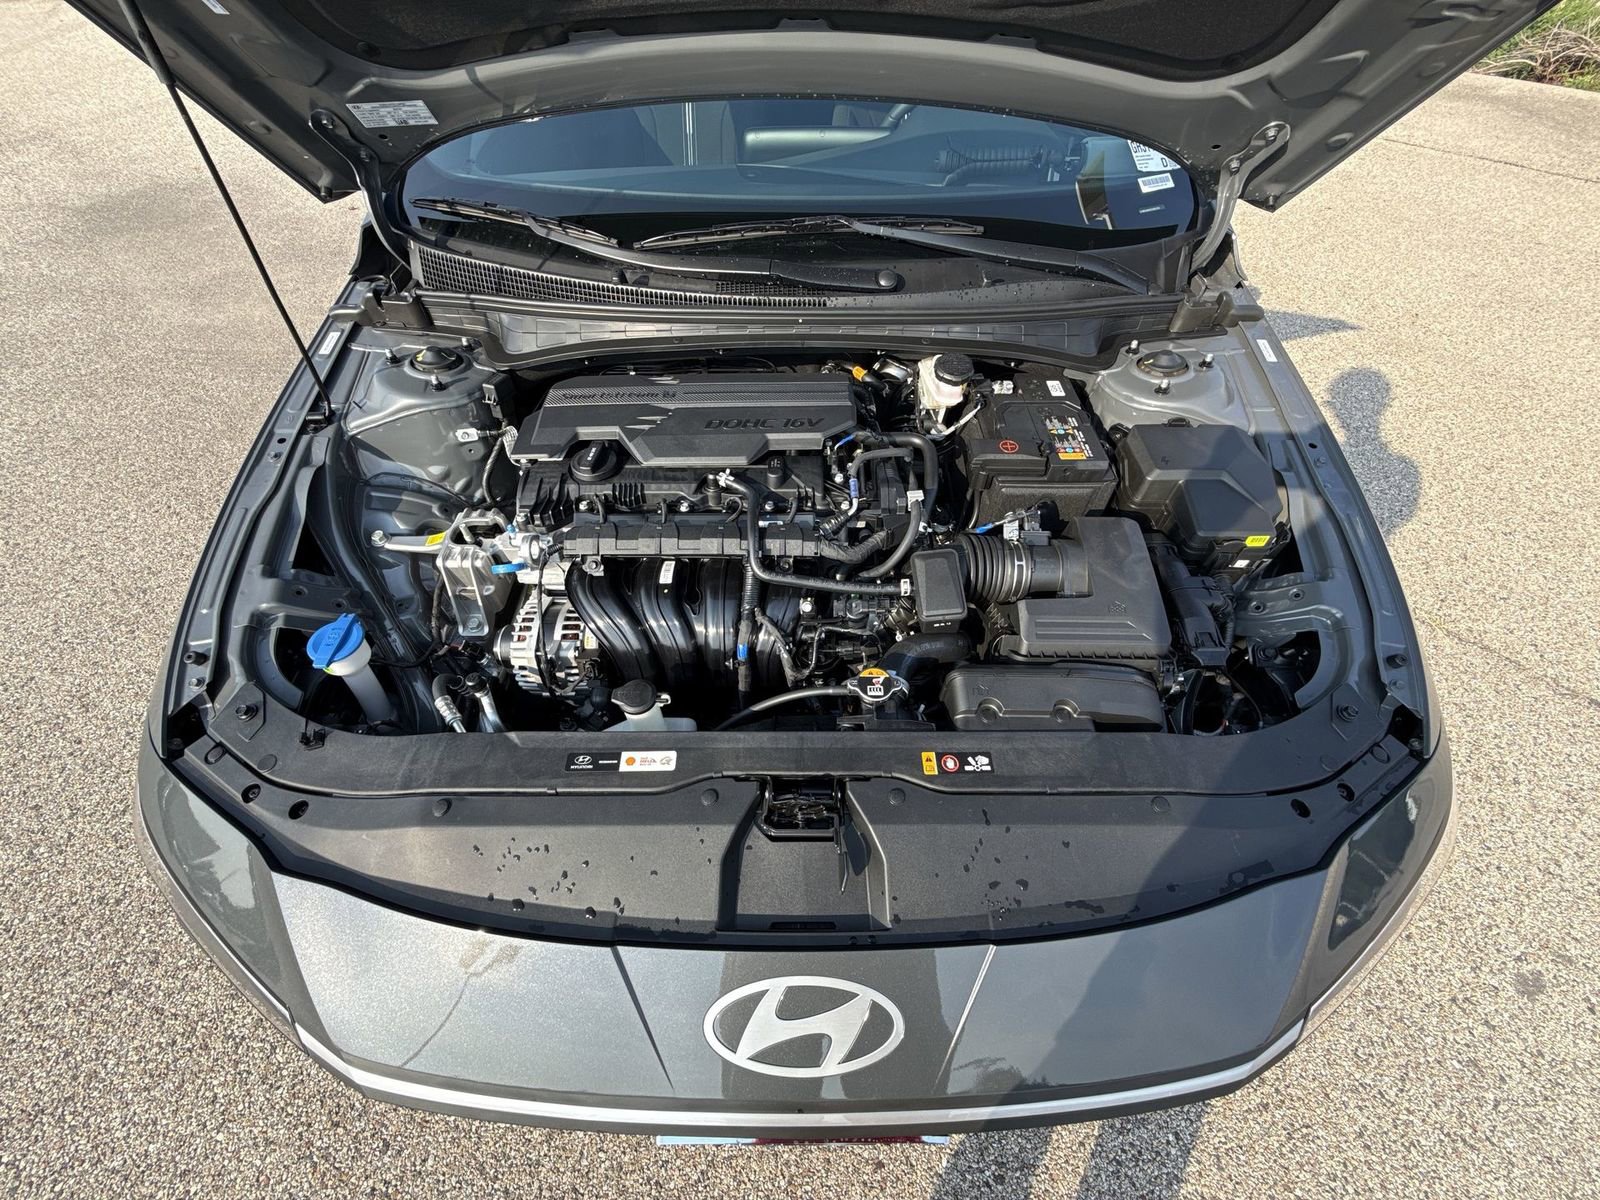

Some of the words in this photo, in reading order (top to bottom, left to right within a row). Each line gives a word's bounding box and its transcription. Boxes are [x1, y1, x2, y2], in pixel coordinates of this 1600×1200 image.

[1161, 157, 1168, 168] D
[704, 417, 777, 430] DOHC
[783, 416, 825, 429] 16V
